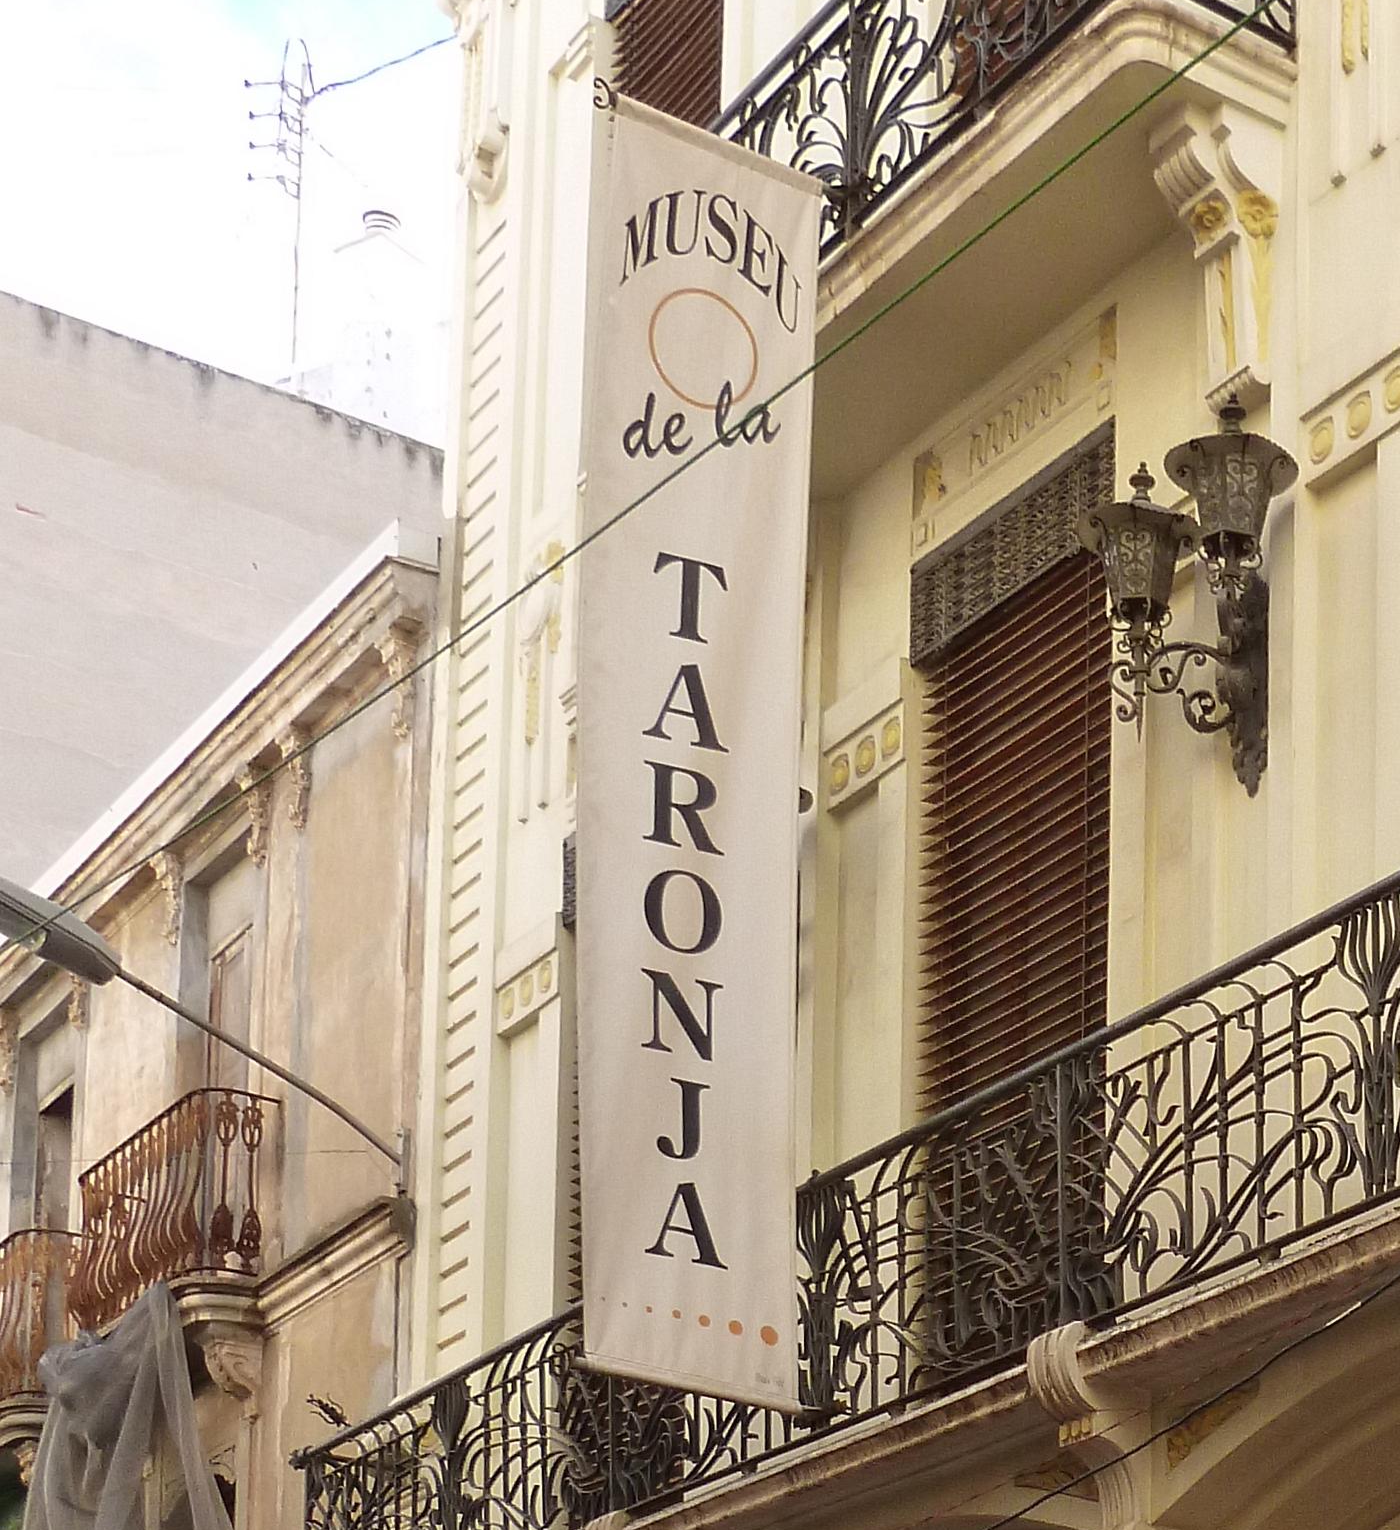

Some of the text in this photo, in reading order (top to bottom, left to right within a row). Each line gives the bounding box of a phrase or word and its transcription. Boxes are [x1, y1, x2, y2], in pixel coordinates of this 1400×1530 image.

[619, 189, 802, 334] MUSEU
[622, 380, 782, 459] de la
[641, 550, 730, 1271] TARONJA
